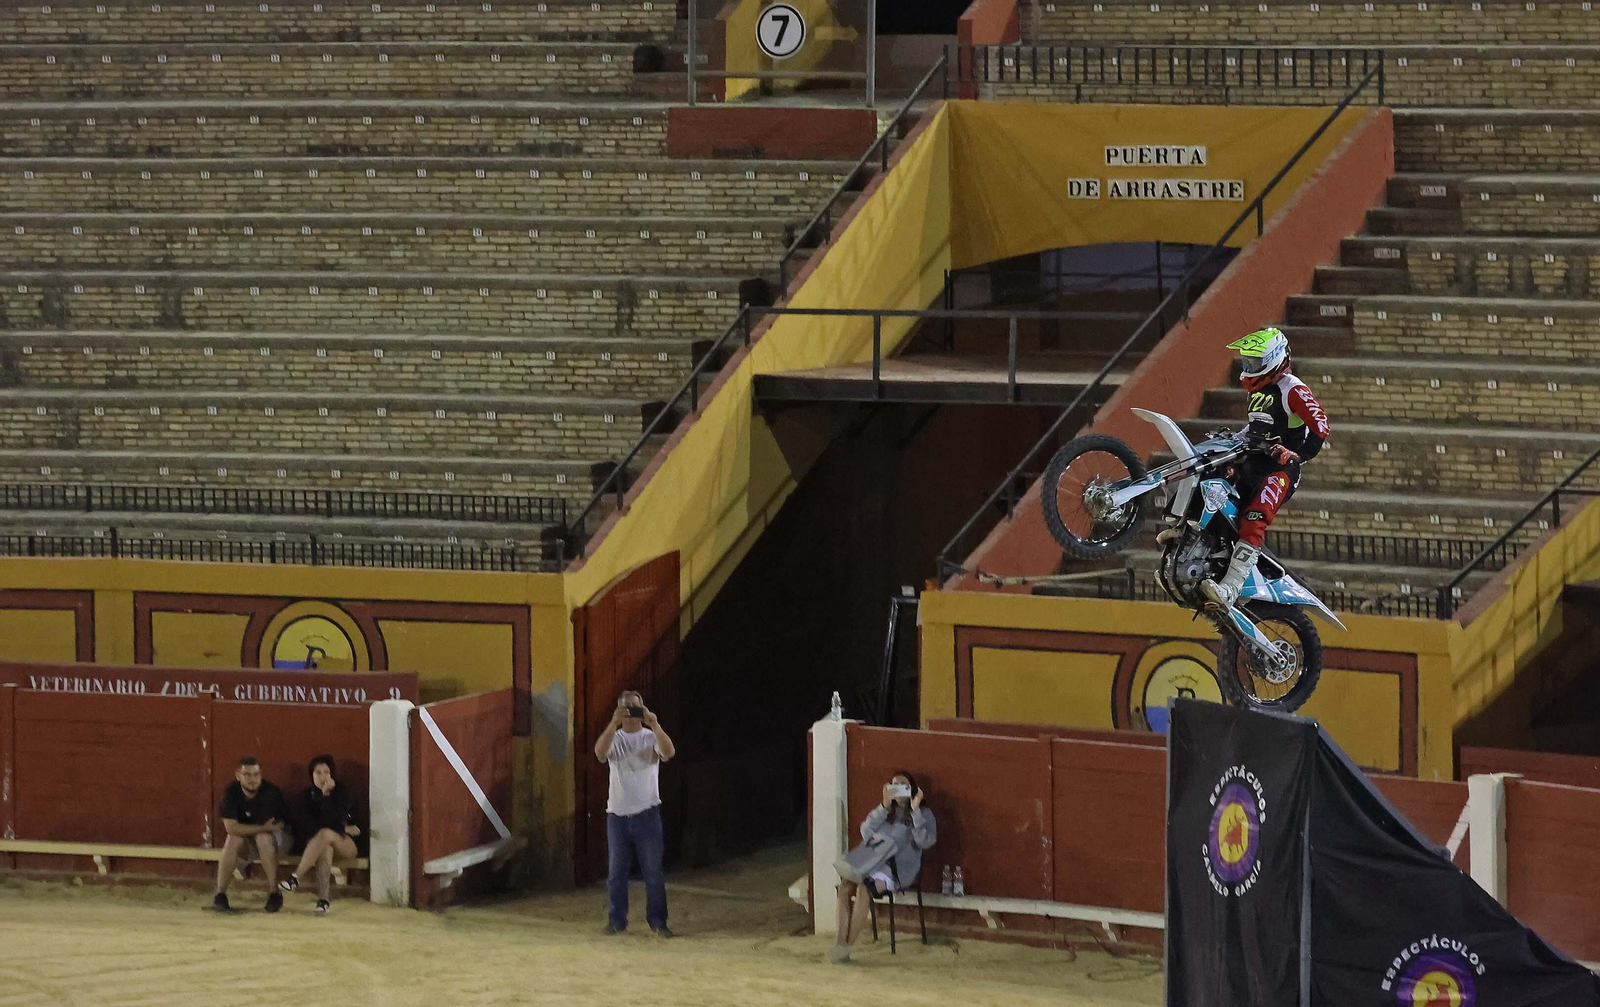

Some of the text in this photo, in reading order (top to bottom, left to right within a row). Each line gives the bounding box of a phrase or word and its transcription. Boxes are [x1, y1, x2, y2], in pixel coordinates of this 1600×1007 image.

[771, 14, 790, 47] 7
[1105, 145, 1204, 165] PUERTA
[1068, 180, 1243, 199] DE ARRASTRE
[29, 675, 147, 696] VETERINARIO
[233, 684, 367, 704] GUBERNATIVO
[1380, 933, 1487, 992] ESPECTÁCULOS
